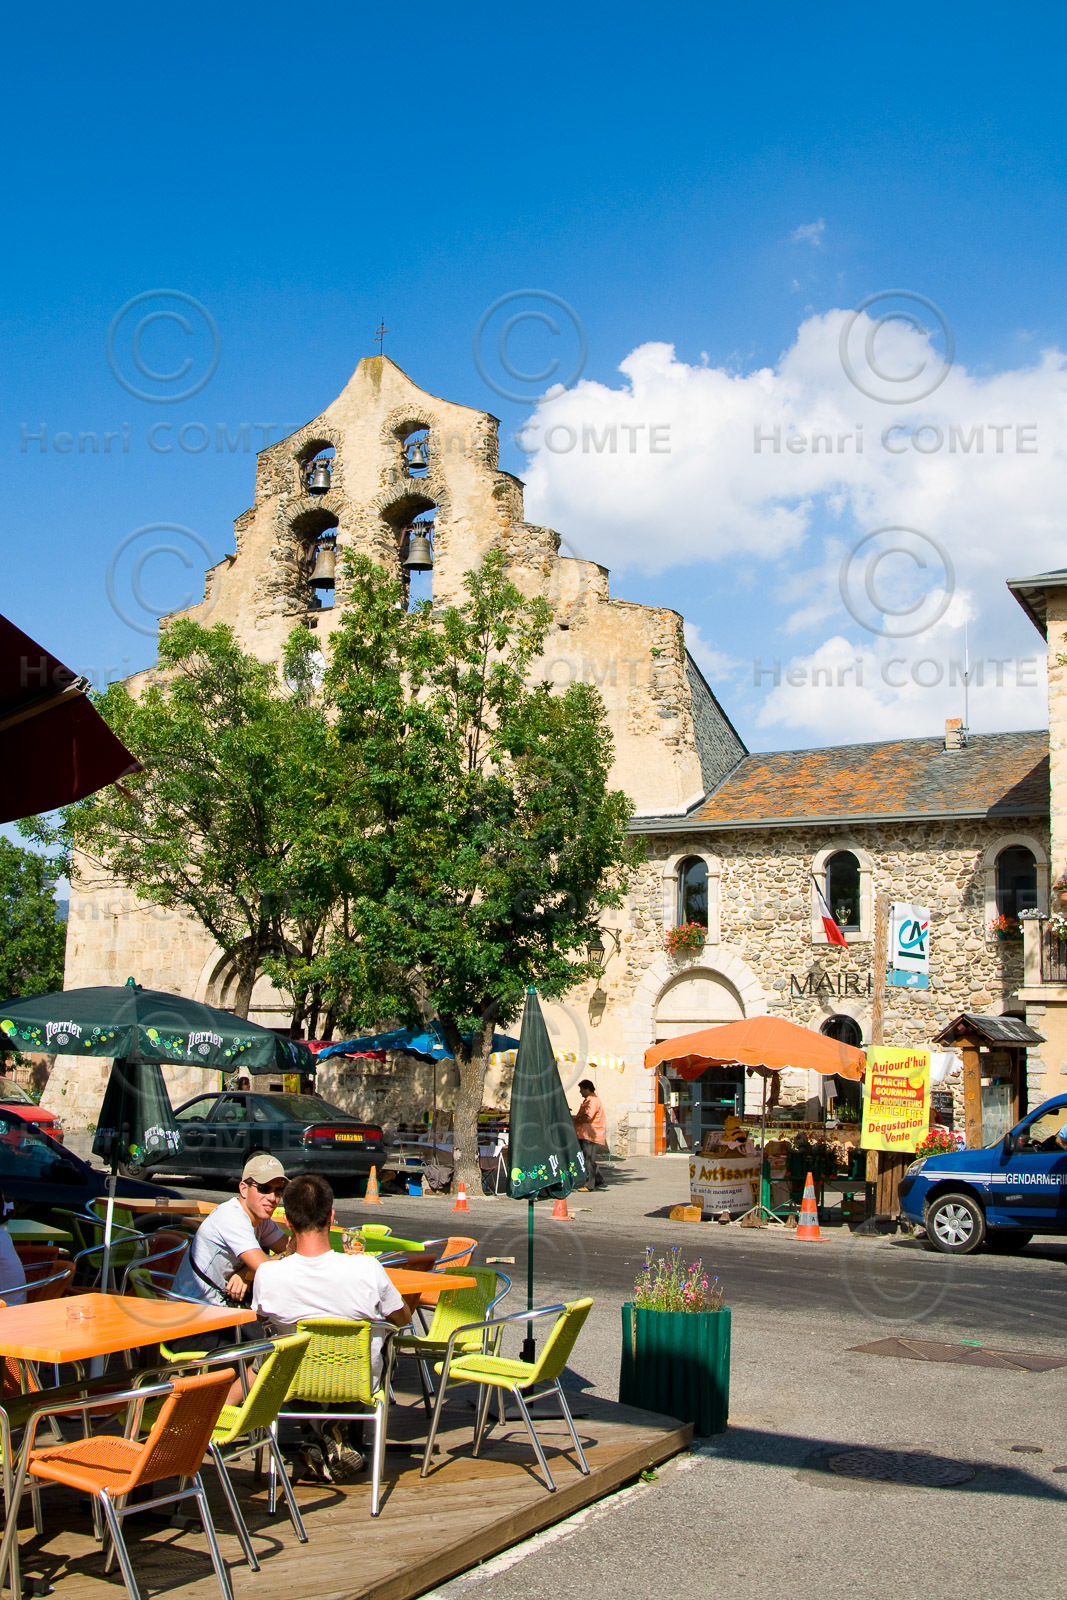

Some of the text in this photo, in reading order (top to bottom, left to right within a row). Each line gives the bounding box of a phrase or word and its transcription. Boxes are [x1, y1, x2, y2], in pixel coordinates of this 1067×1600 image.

[790, 972, 873, 995] MAIRI
[872, 1056, 926, 1074] Aujourd'hui
[875, 1087, 917, 1098] GOURMAND
[880, 1097, 923, 1107] PRODUCTEURS
[868, 1119, 923, 1135] Dégustation
[885, 1133, 910, 1143] Vente
